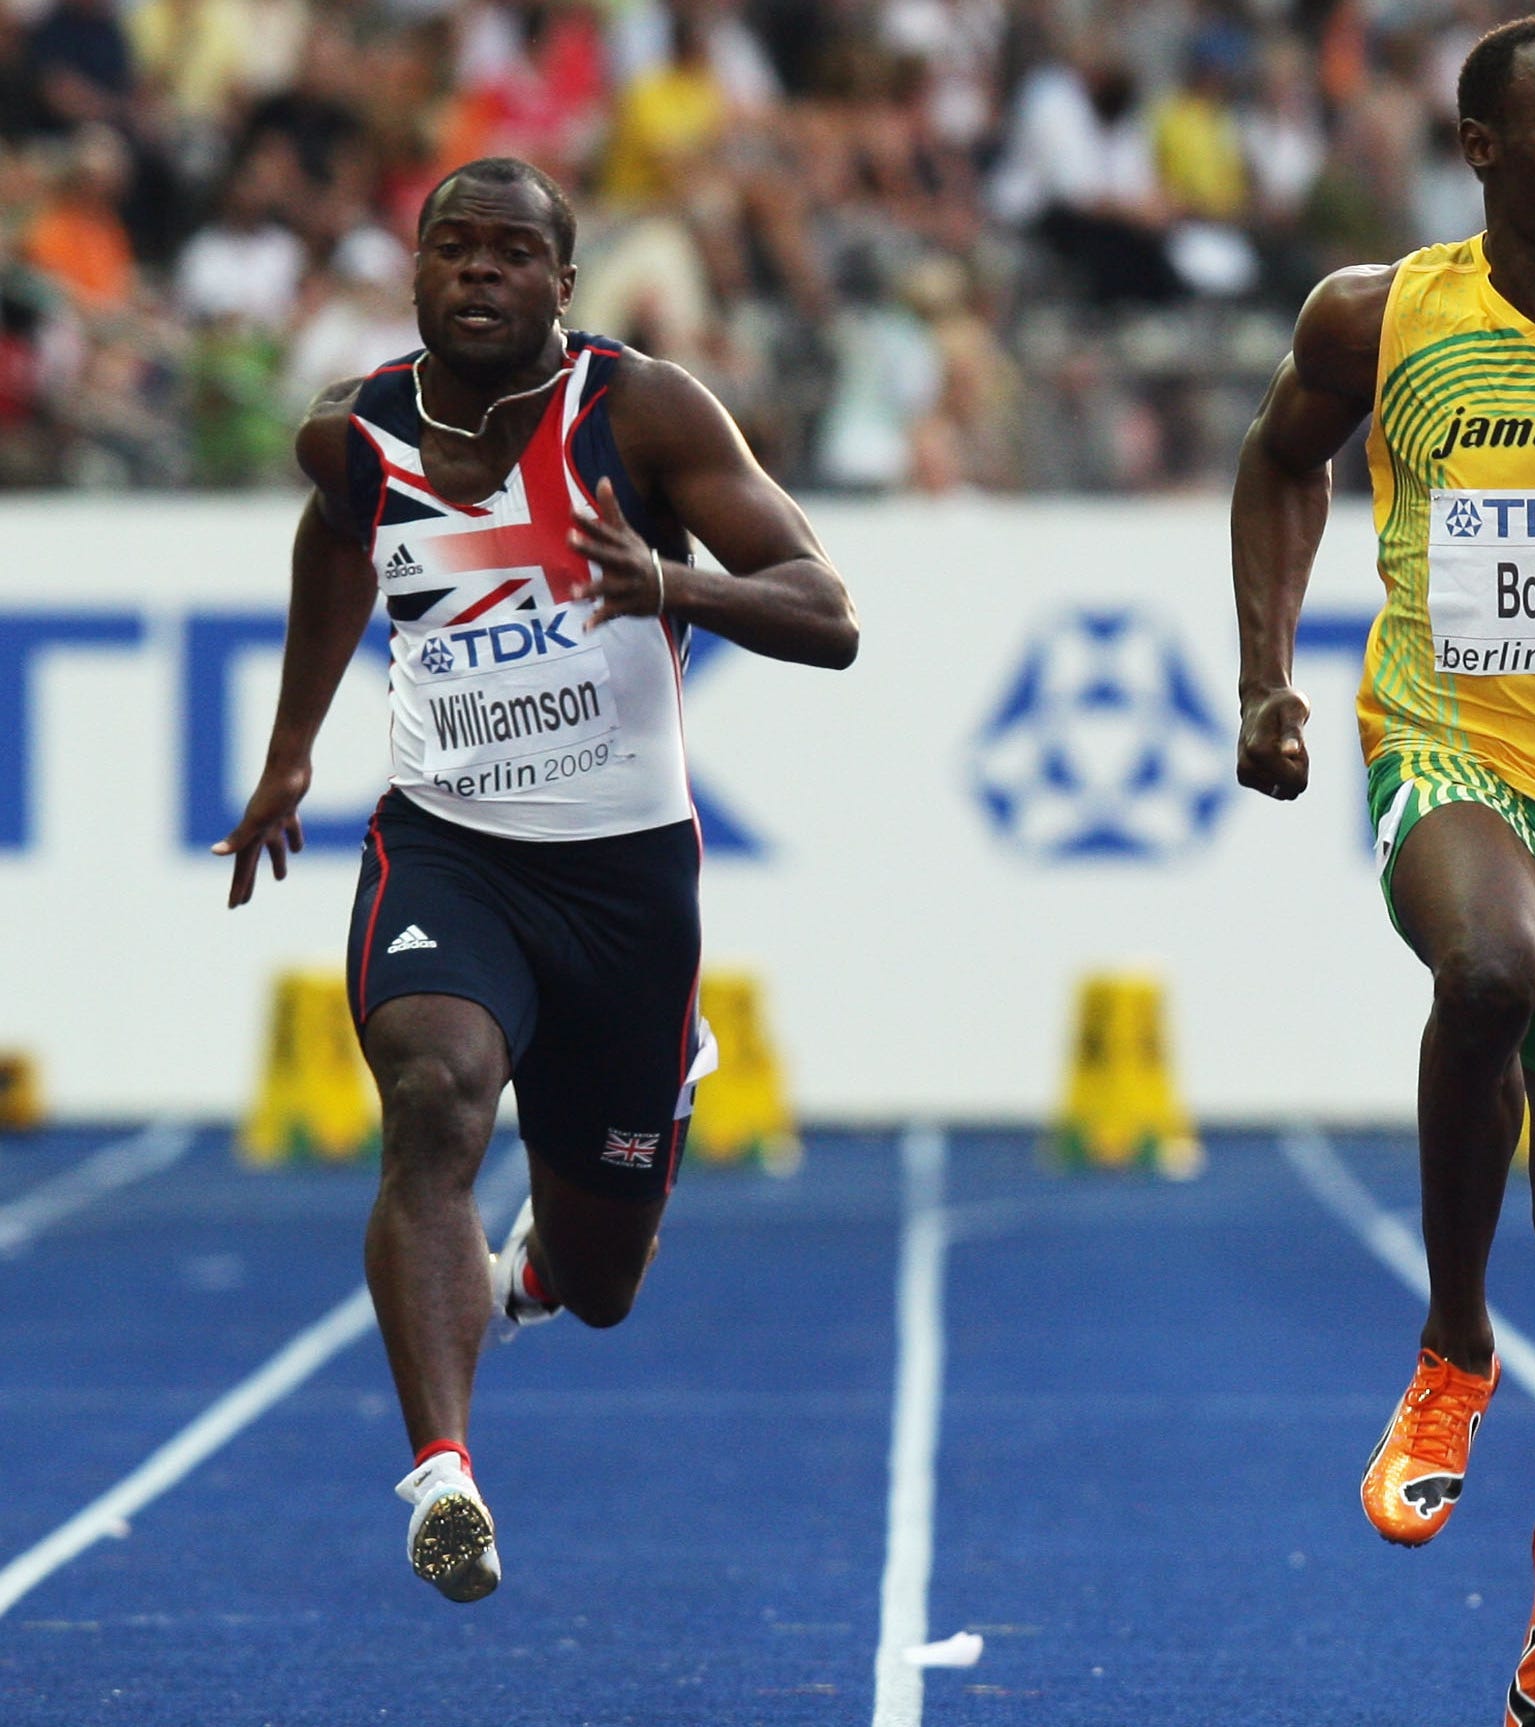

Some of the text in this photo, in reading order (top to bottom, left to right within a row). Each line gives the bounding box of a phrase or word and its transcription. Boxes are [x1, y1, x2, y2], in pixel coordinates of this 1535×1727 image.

[385, 564, 423, 579] adidas
[450, 610, 578, 668] TDK
[429, 680, 600, 751] Williamson
[544, 743, 609, 782] 2009
[387, 940, 437, 954] adidas
